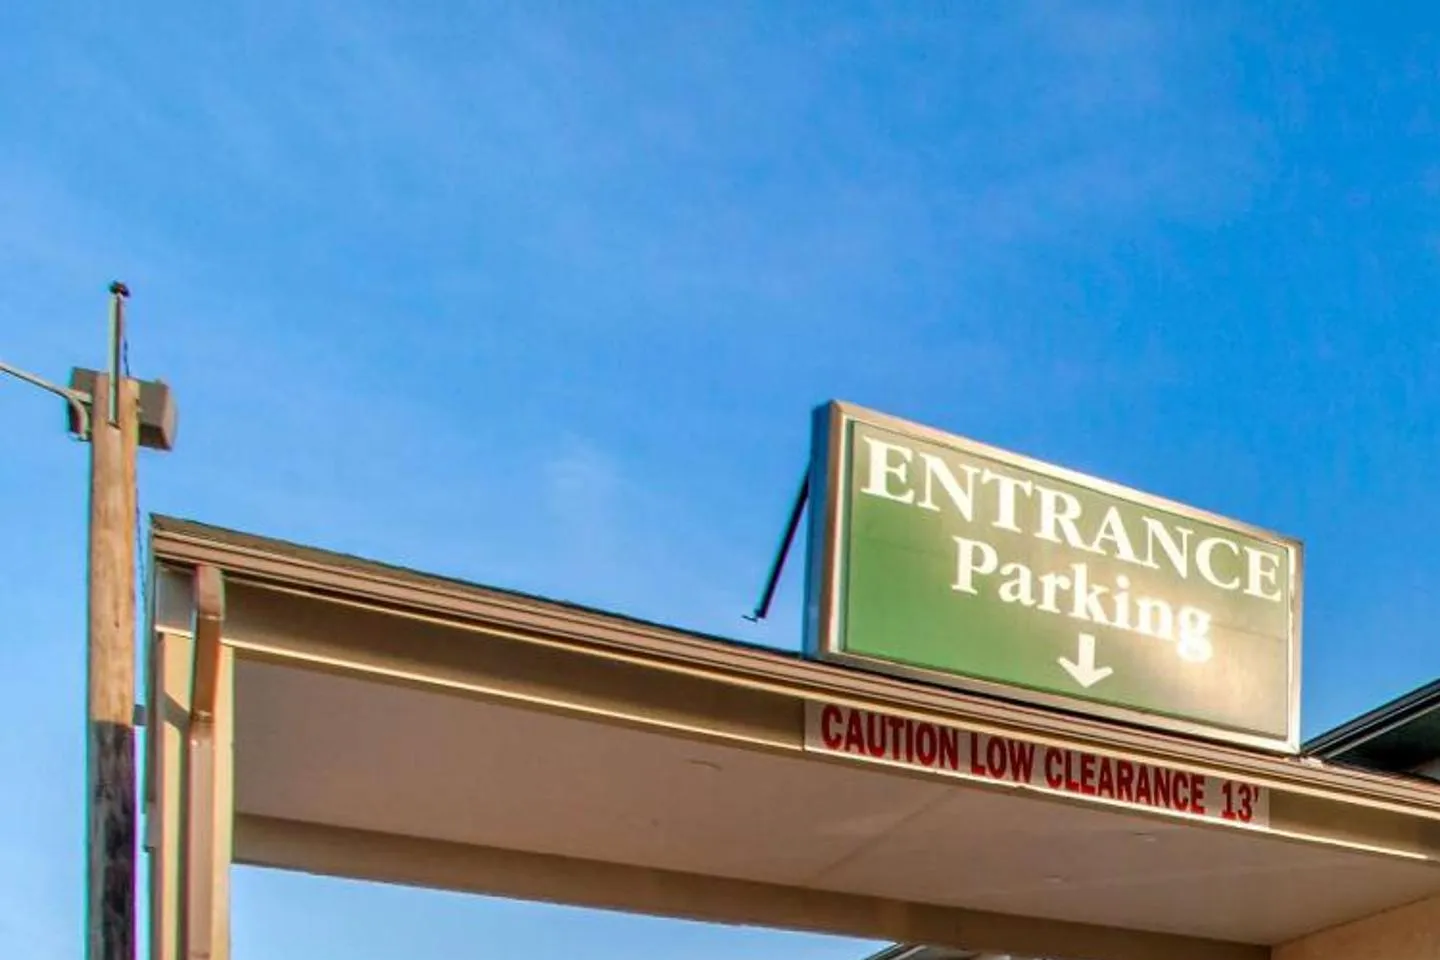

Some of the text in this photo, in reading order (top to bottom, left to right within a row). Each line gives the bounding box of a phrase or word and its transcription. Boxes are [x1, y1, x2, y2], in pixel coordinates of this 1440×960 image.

[861, 436, 1282, 601] ENTRANCE
[951, 536, 1213, 664] Parking
[821, 704, 1259, 822] CAUTION LOW CLEARANCE 13'
